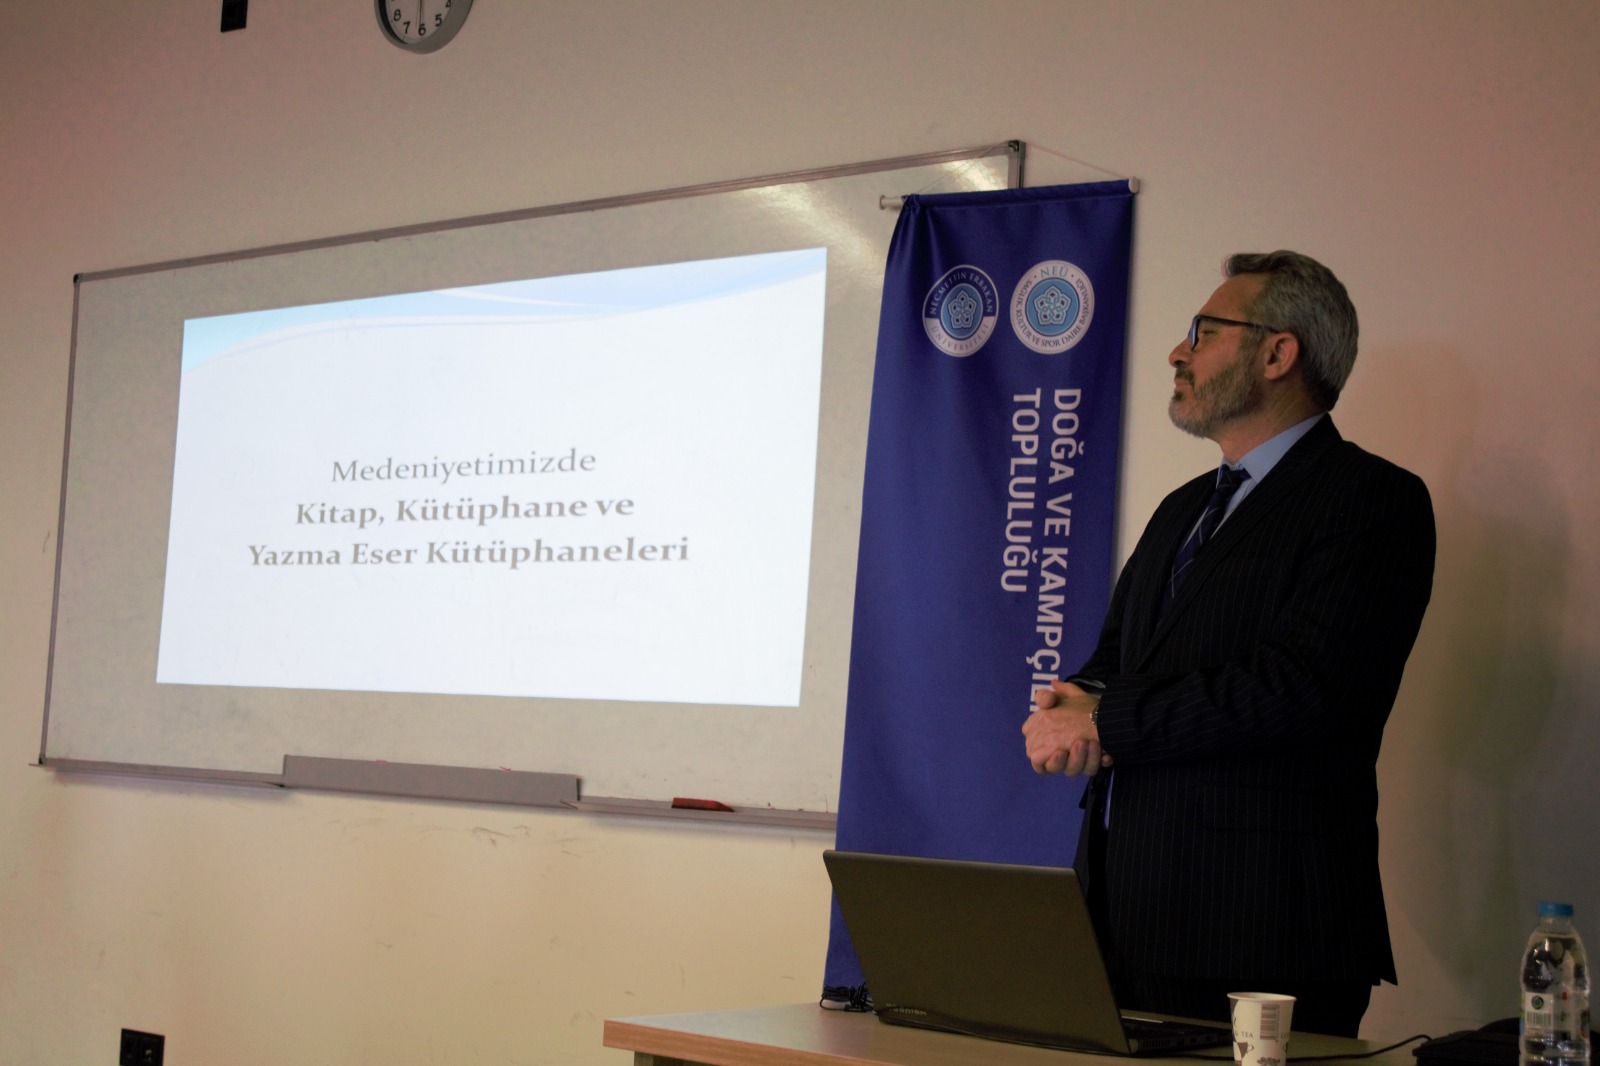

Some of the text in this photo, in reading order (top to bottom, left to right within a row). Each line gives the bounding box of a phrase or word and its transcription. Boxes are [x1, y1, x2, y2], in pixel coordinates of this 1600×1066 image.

[393, 8, 402, 22] 8
[403, 21, 411, 34] 7
[418, 23, 426, 36] 6
[434, 13, 443, 27] 5
[1040, 263, 1068, 279] NEÜ
[969, 272, 994, 313] ERBAKAN
[1041, 339, 1061, 348] SPOR
[1048, 388, 1084, 485] DOĞA
[332, 447, 597, 485] Medeniyetimizde
[1000, 387, 1041, 593] TOPLULUĞU
[296, 495, 635, 530] Kitap, Kütüphane ve
[1044, 493, 1073, 537] VE
[247, 536, 690, 571] Yazma Eser Kütüphaneleri
